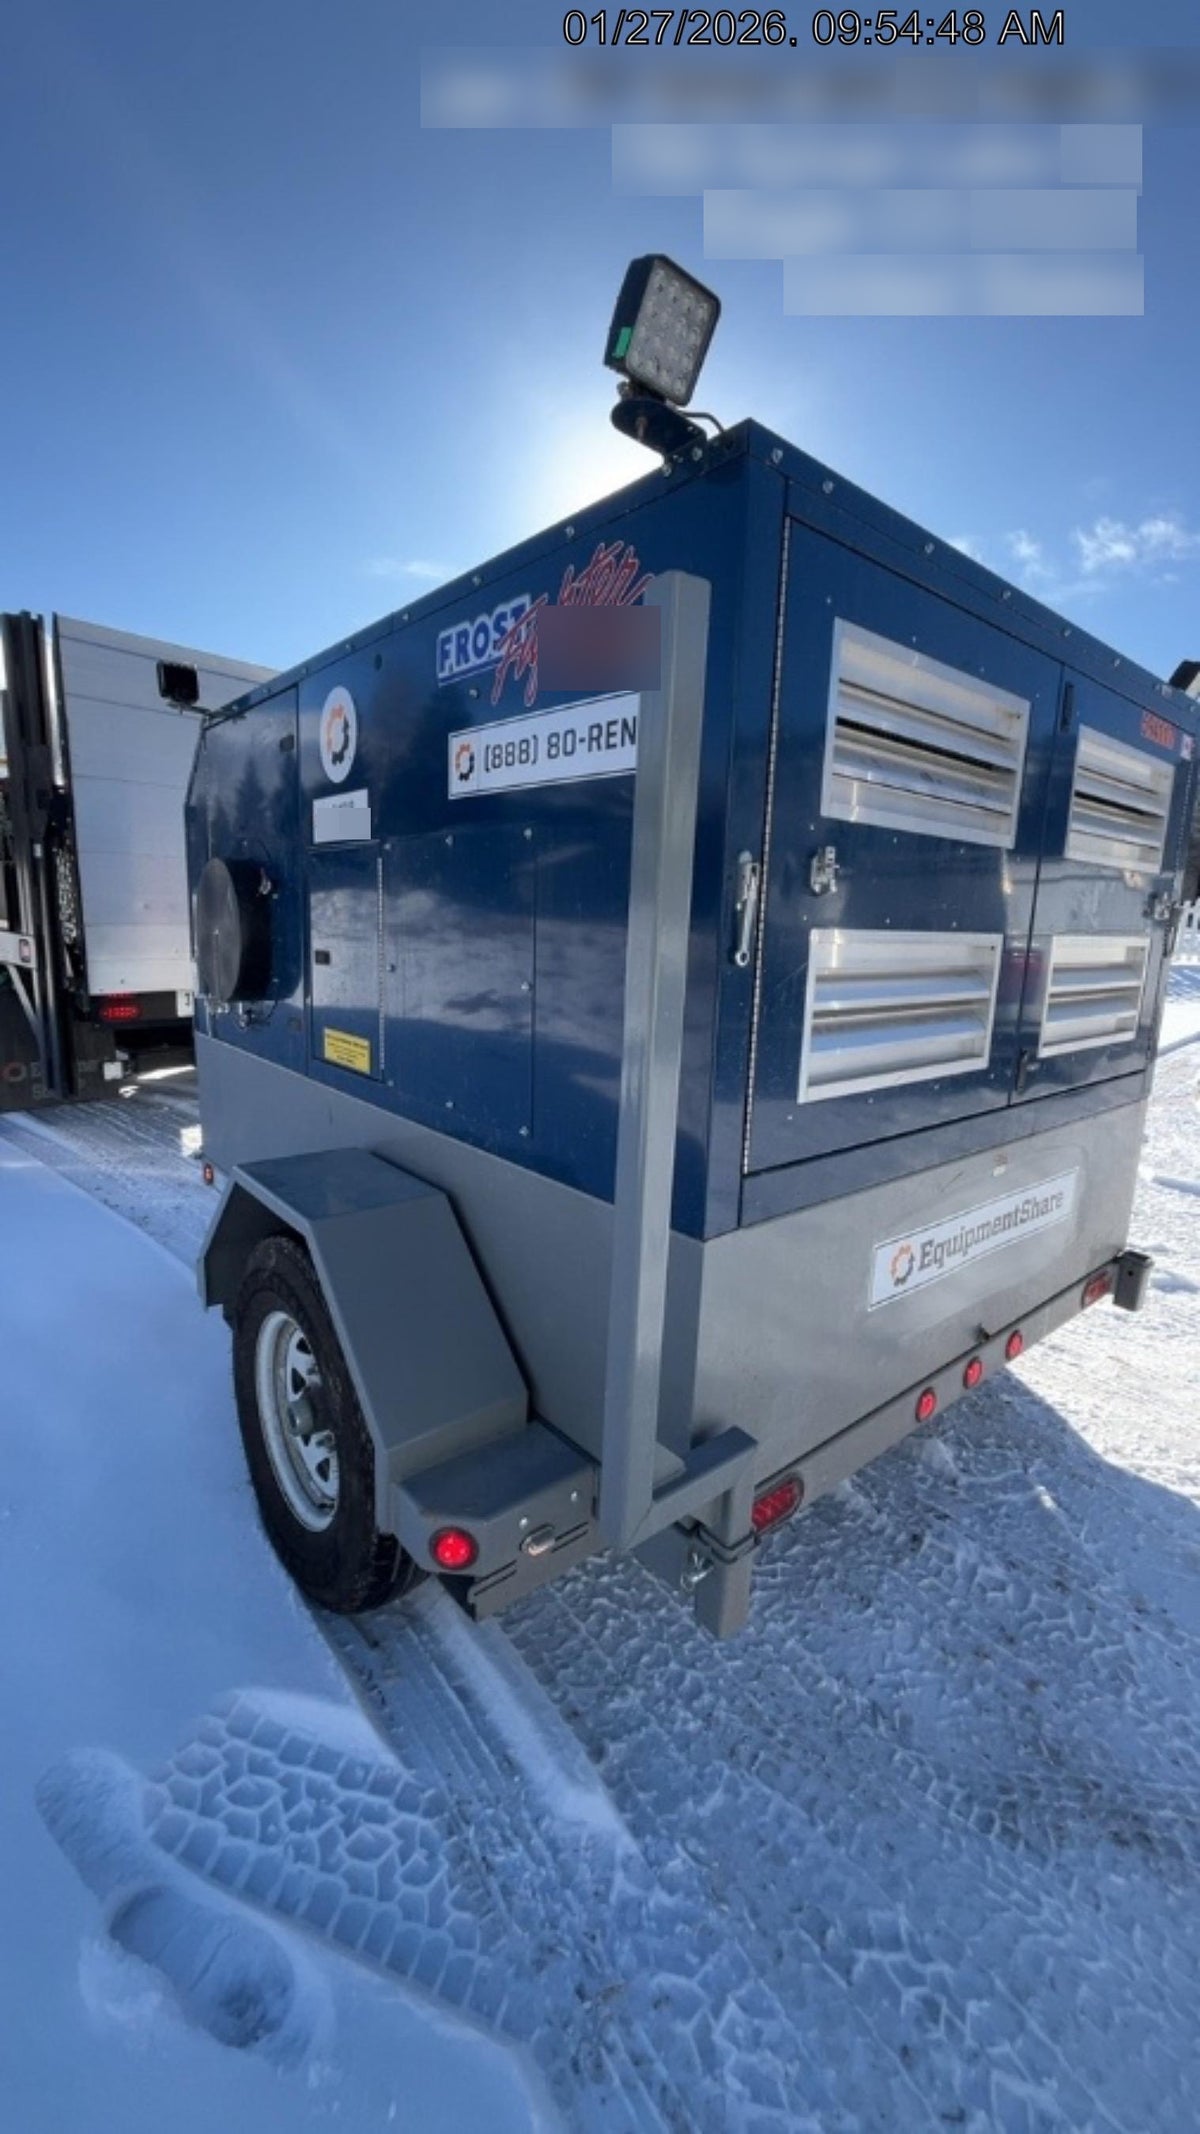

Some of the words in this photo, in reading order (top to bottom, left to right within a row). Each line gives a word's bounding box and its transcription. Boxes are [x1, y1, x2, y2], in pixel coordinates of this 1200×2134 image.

[438, 598, 530, 675] FROST
[484, 734, 539, 773] (888)
[547, 716, 637, 761] 80-REN
[918, 1191, 1064, 1271] EquipmentShare
